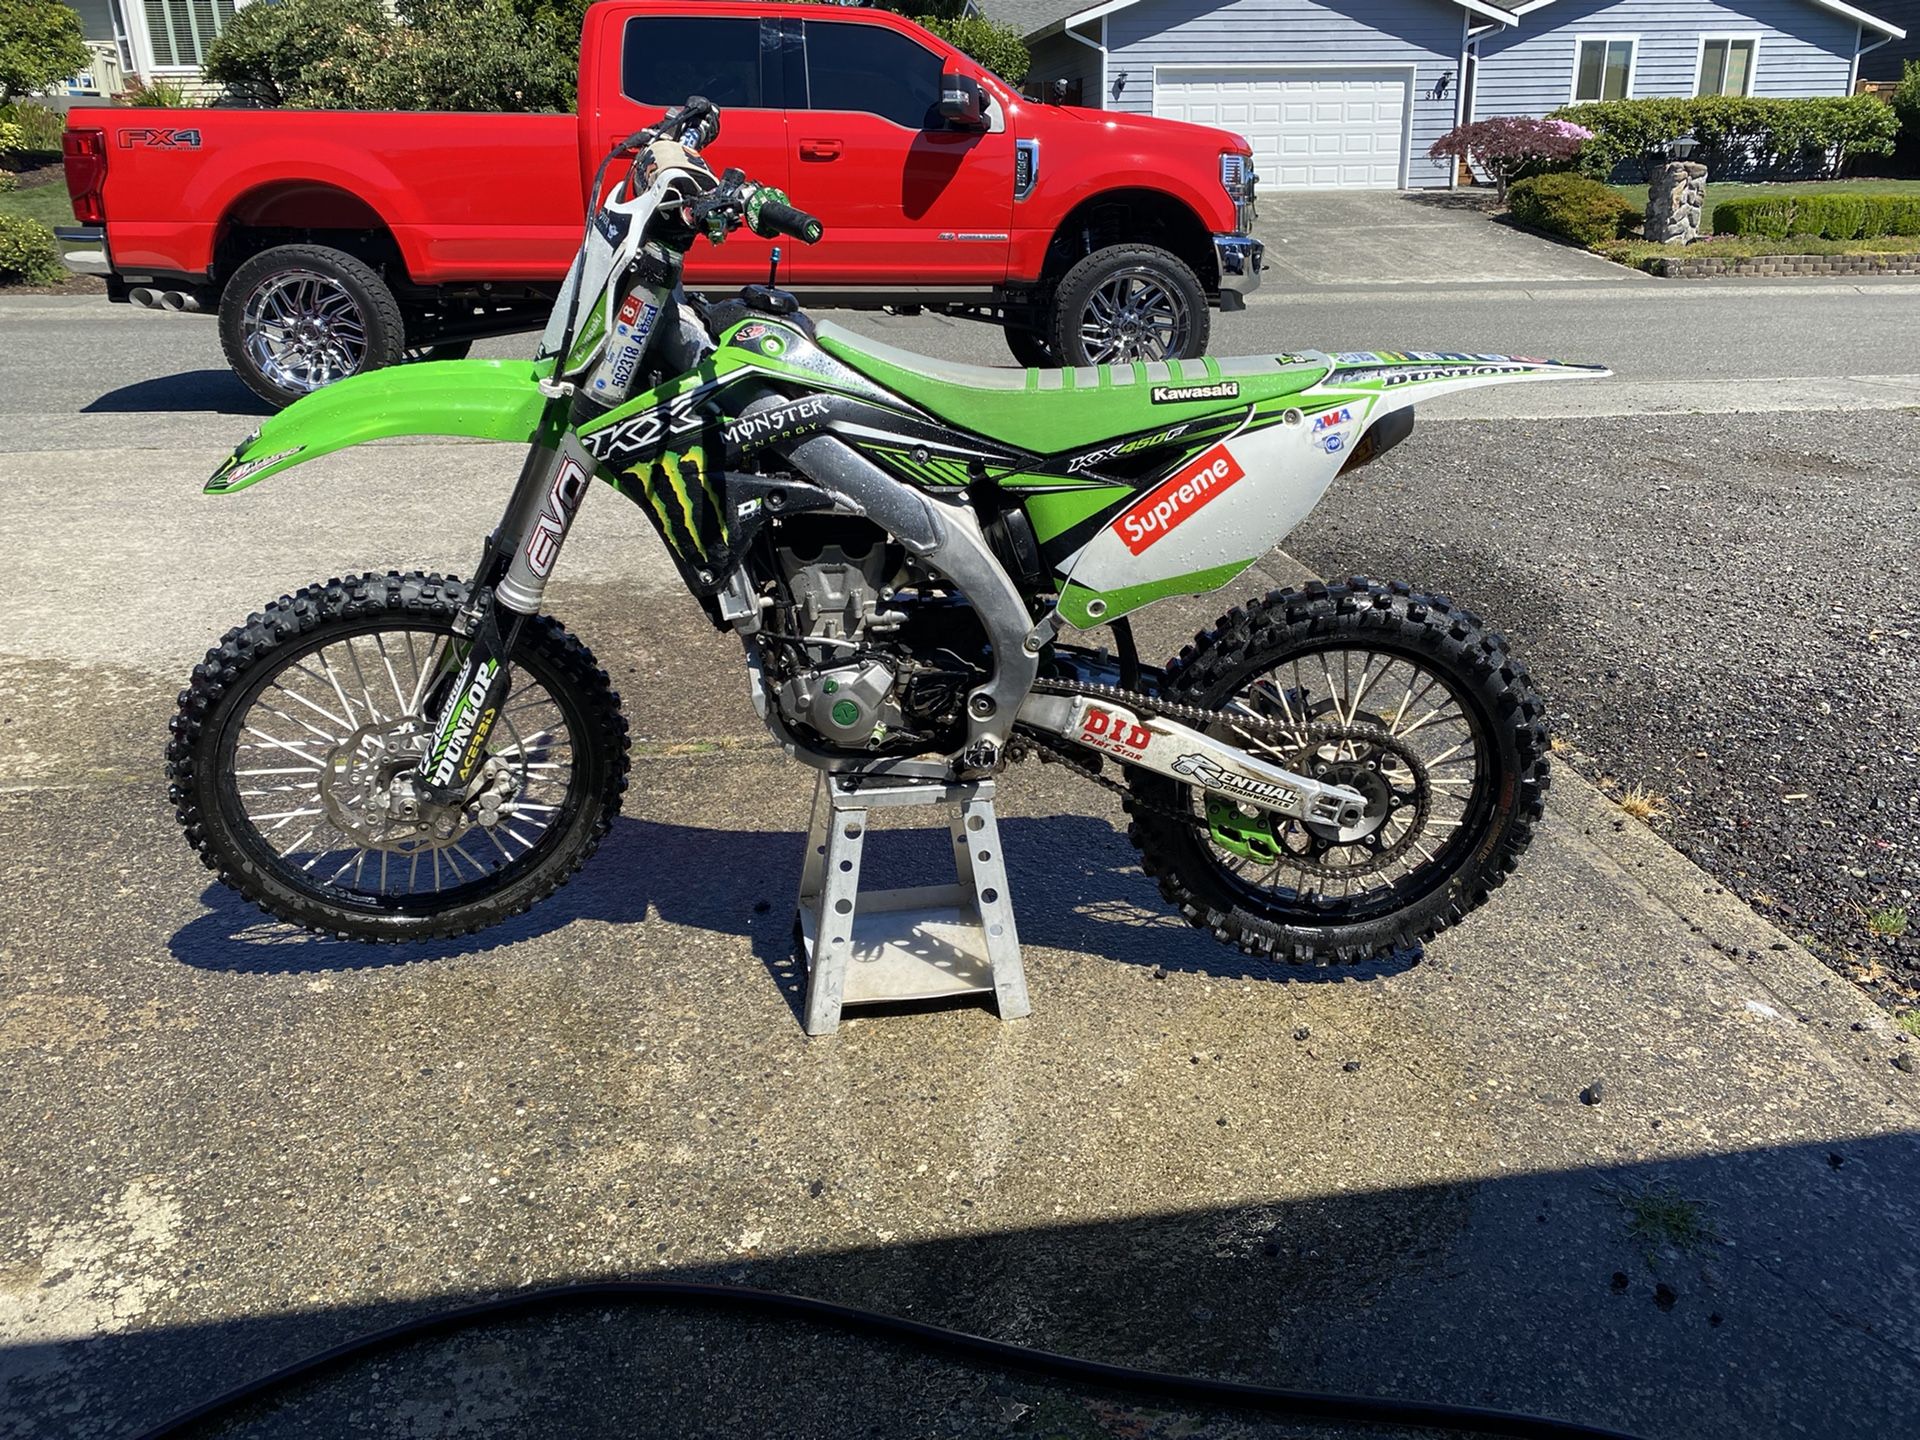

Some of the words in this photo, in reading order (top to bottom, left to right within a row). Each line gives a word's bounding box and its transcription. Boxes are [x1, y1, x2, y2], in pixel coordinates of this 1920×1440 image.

[118, 129, 201, 149] FX4
[622, 305, 635, 318] 8
[611, 346, 640, 389] 562318
[1153, 383, 1239, 401] Kawasaki
[722, 399, 830, 445] MONSTER
[741, 423, 821, 453] ENERGY
[1312, 408, 1352, 432] AMA
[1067, 425, 1190, 473] KX450F
[1123, 457, 1231, 543] Supreme
[435, 662, 492, 787] DUNLOP
[1171, 753, 1300, 803] RENTHAL
[1222, 785, 1293, 810] CHAINWHEELS
